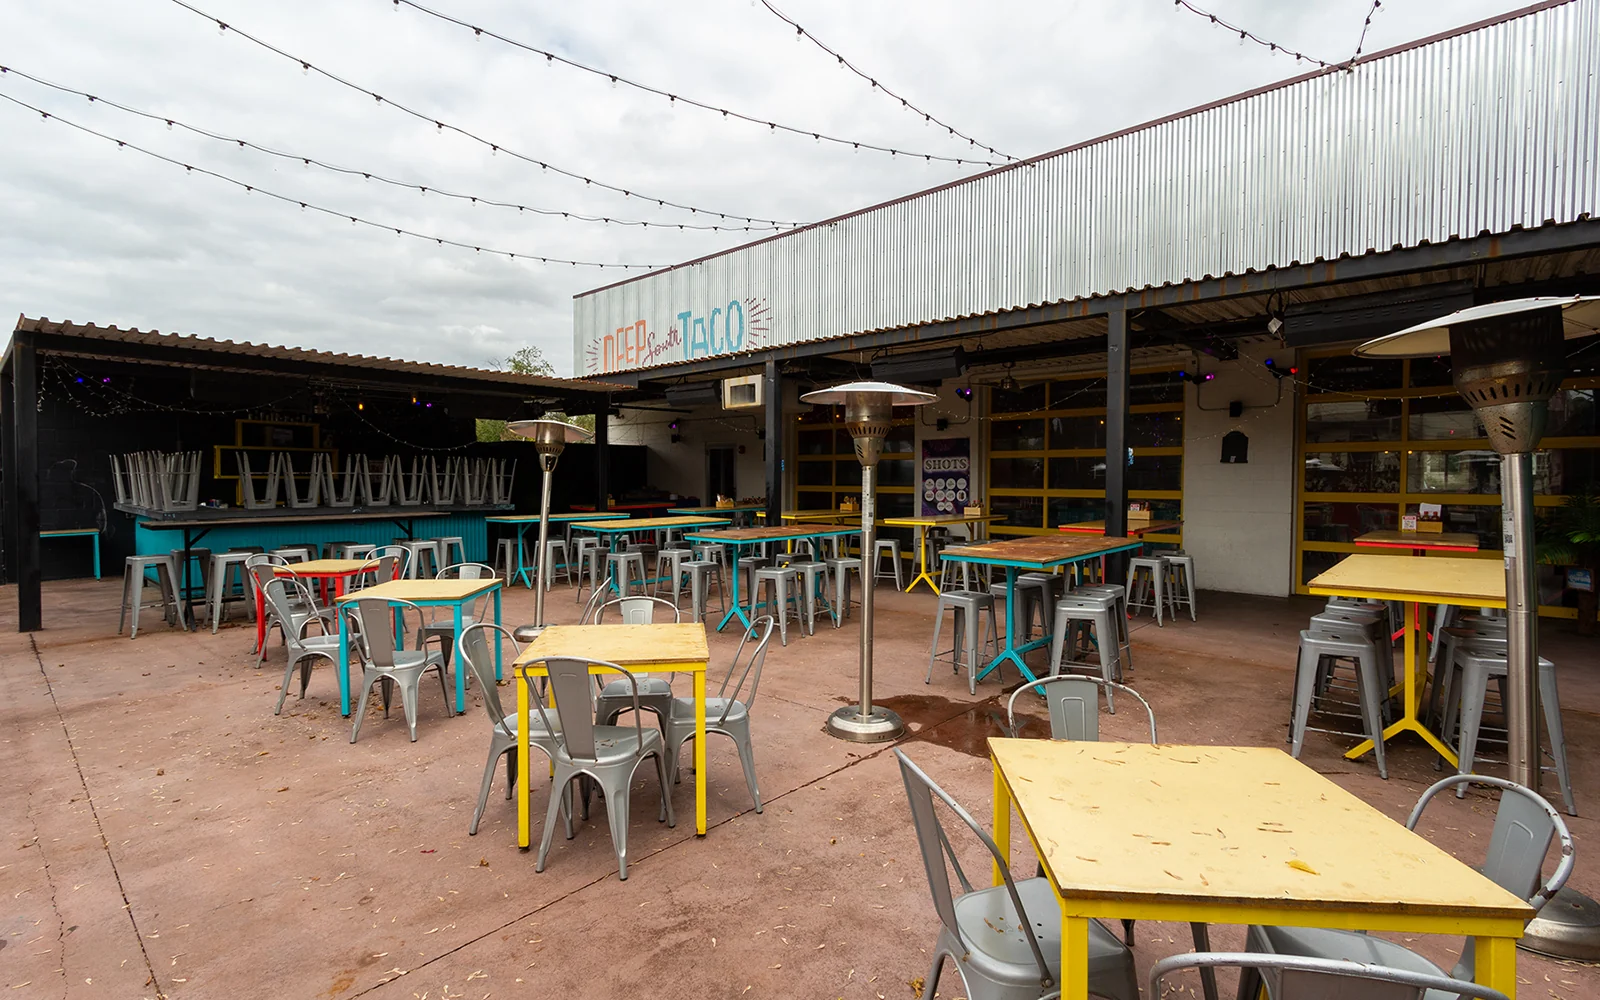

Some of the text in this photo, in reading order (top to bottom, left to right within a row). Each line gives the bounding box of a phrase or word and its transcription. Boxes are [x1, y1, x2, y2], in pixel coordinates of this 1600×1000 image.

[603, 299, 744, 372] DEEP South TACO
[925, 458, 967, 470] SHOTS
